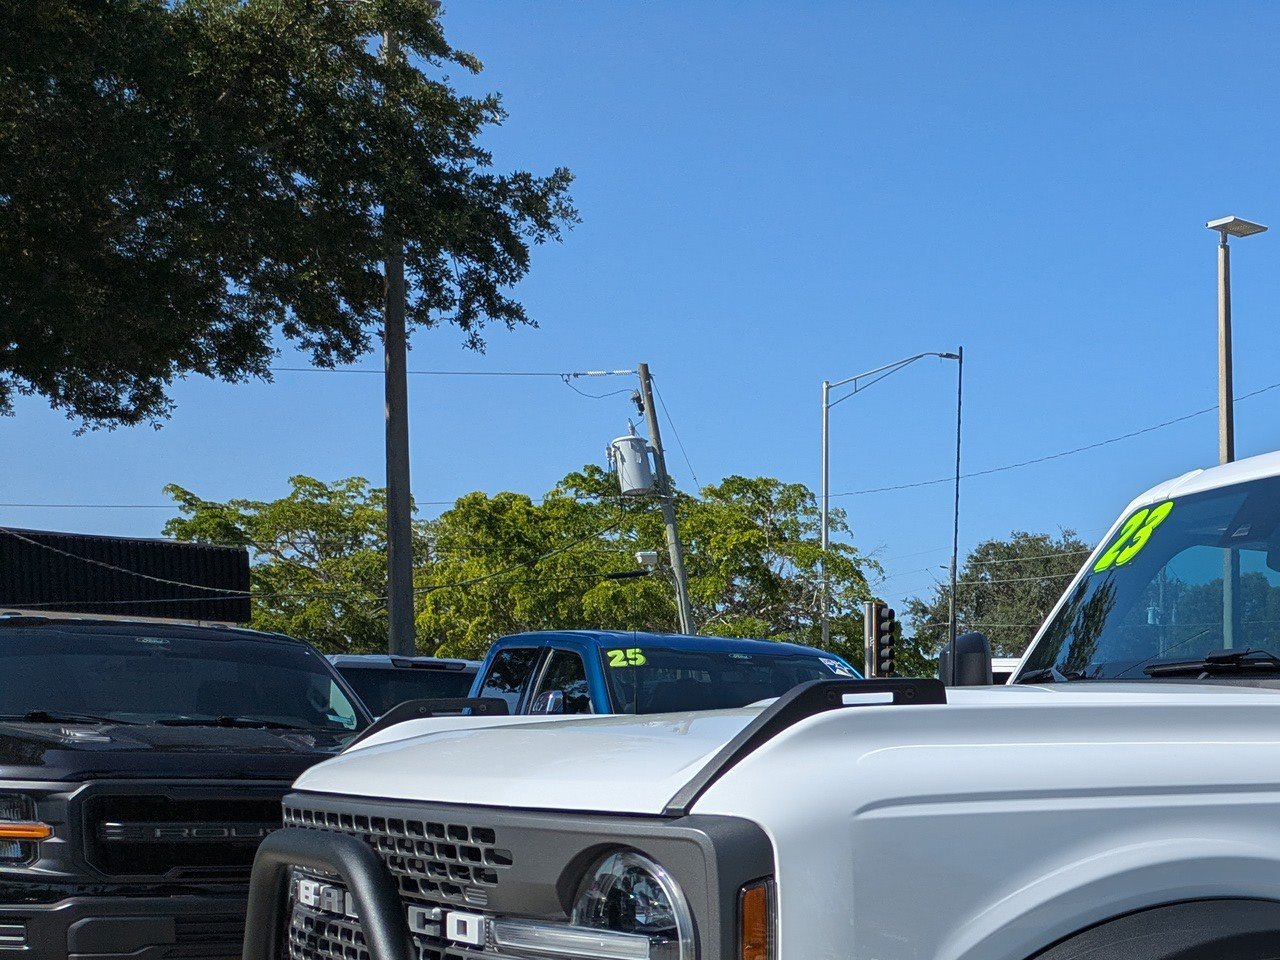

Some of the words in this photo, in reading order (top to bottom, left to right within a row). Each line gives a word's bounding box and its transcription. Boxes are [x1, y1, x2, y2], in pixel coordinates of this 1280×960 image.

[1092, 500, 1175, 573] 23
[606, 648, 647, 668] 25
[298, 879, 486, 946] BRCO
